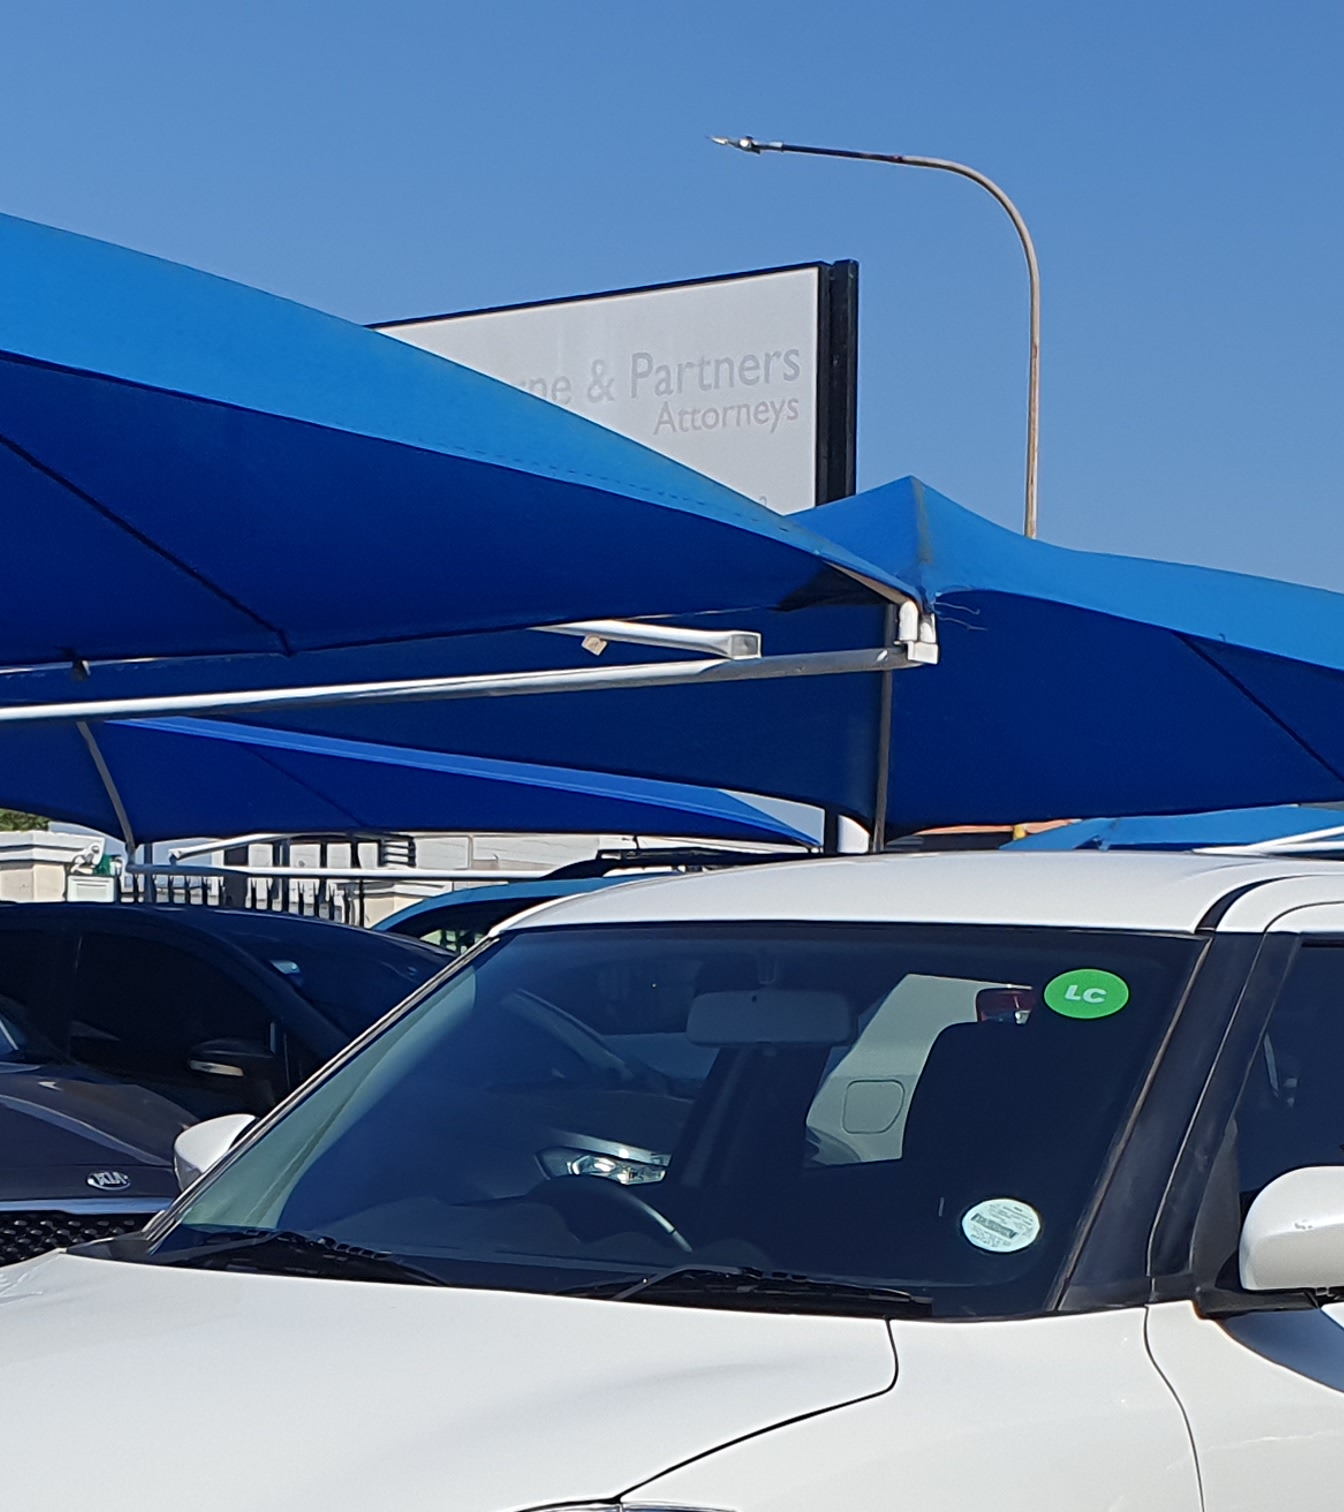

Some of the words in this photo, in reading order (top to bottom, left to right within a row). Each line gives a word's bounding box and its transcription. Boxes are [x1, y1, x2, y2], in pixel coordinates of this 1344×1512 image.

[516, 375, 572, 405] ne
[587, 359, 615, 403] &
[631, 348, 801, 398] Partners
[654, 397, 800, 435] Attorneys
[1064, 984, 1108, 1004] LC
